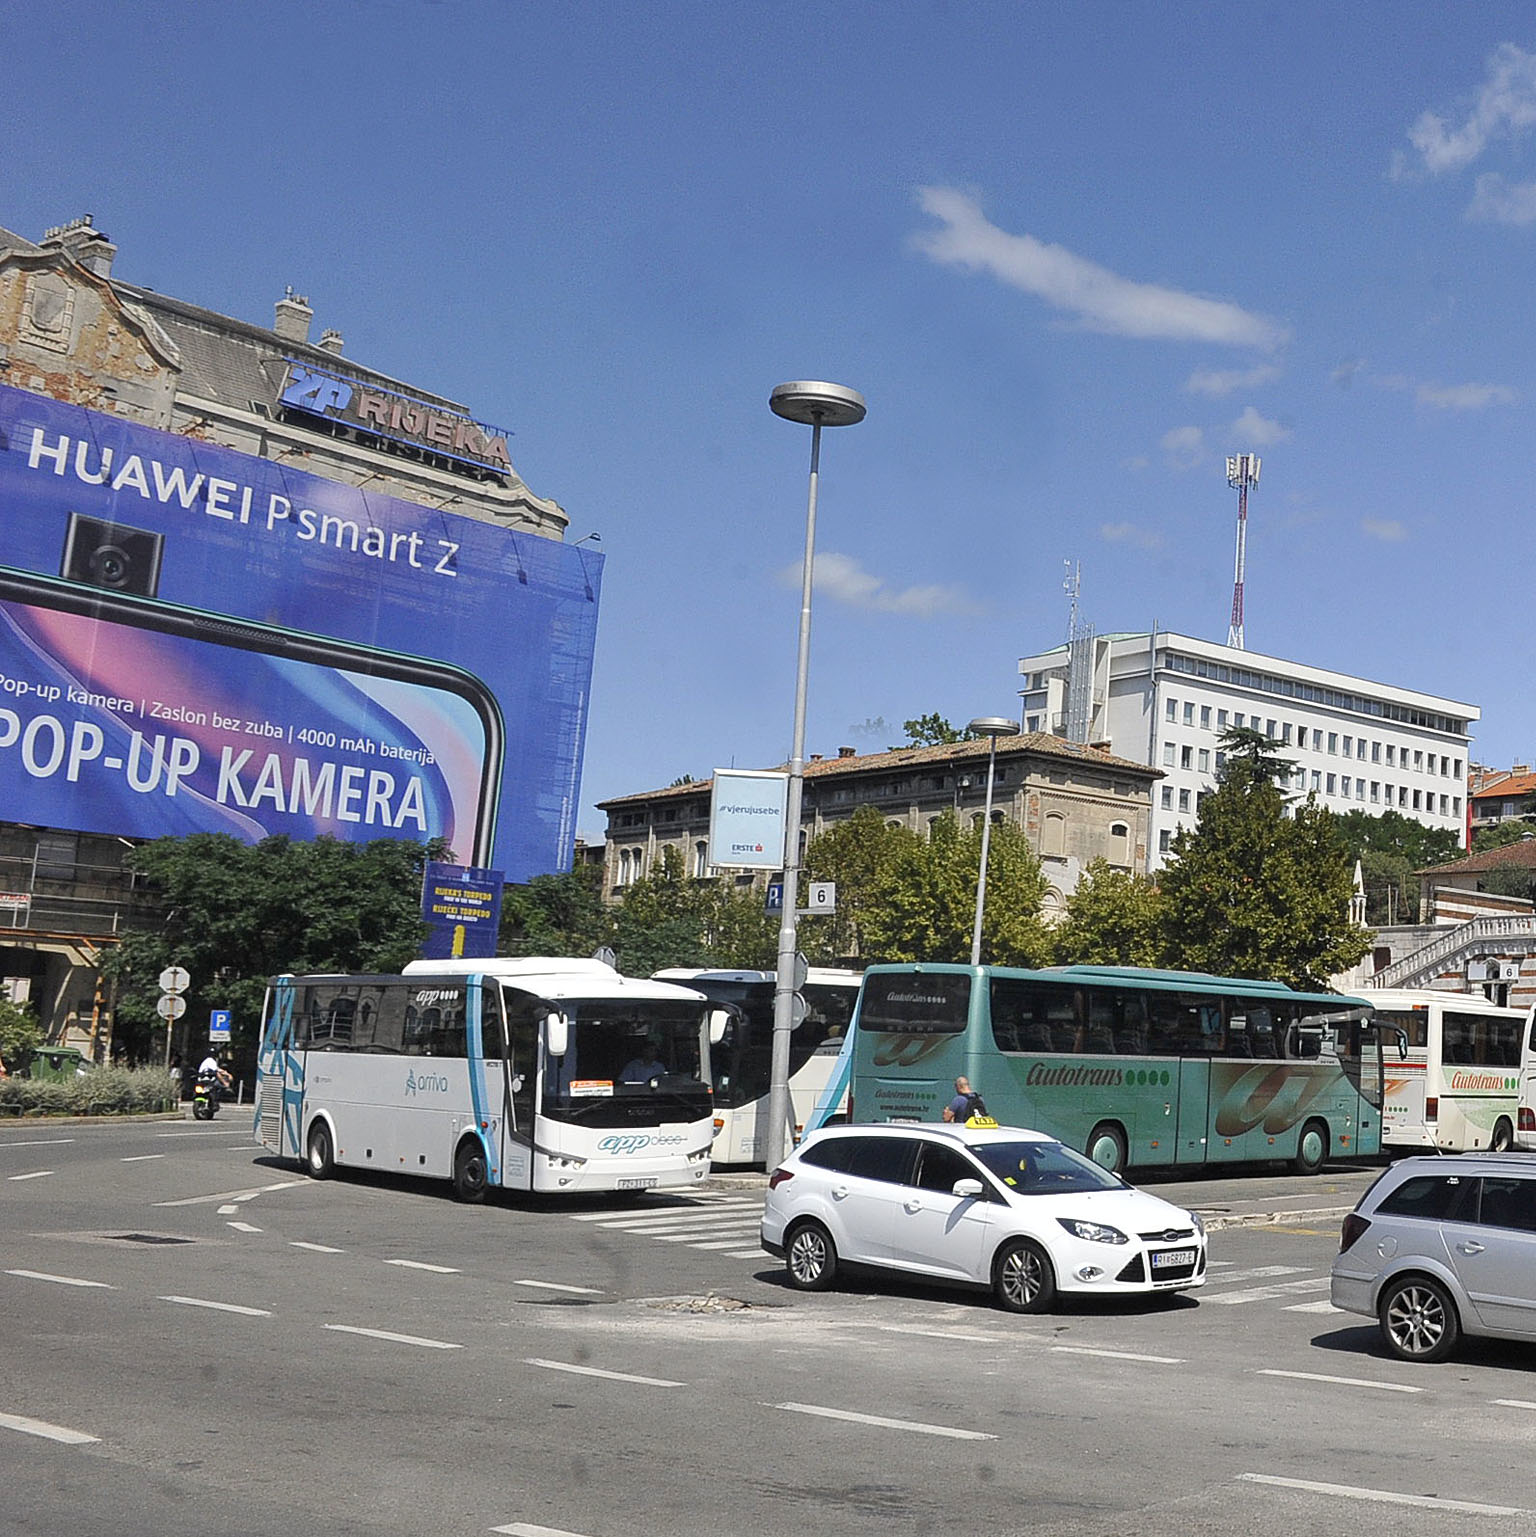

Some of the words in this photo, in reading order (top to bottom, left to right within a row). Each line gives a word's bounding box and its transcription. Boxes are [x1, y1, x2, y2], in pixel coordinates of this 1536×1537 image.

[357, 391, 511, 465] RIJEKA
[28, 428, 253, 524] HUAWEI
[267, 494, 291, 530] P
[297, 508, 423, 568] smart
[434, 539, 460, 577] Z
[67, 686, 134, 713] kamera
[150, 701, 206, 726] Zaslon
[212, 712, 240, 732] bez
[245, 721, 284, 738] zuba
[297, 728, 336, 747] 4000
[340, 738, 375, 754] mAh
[380, 742, 435, 767] baterija
[216, 745, 428, 831] KAMERA
[817, 890, 826, 903] 6
[1506, 968, 1513, 977] 6
[416, 990, 439, 1005] app
[216, 1014, 227, 1028] P
[598, 1135, 651, 1155] app
